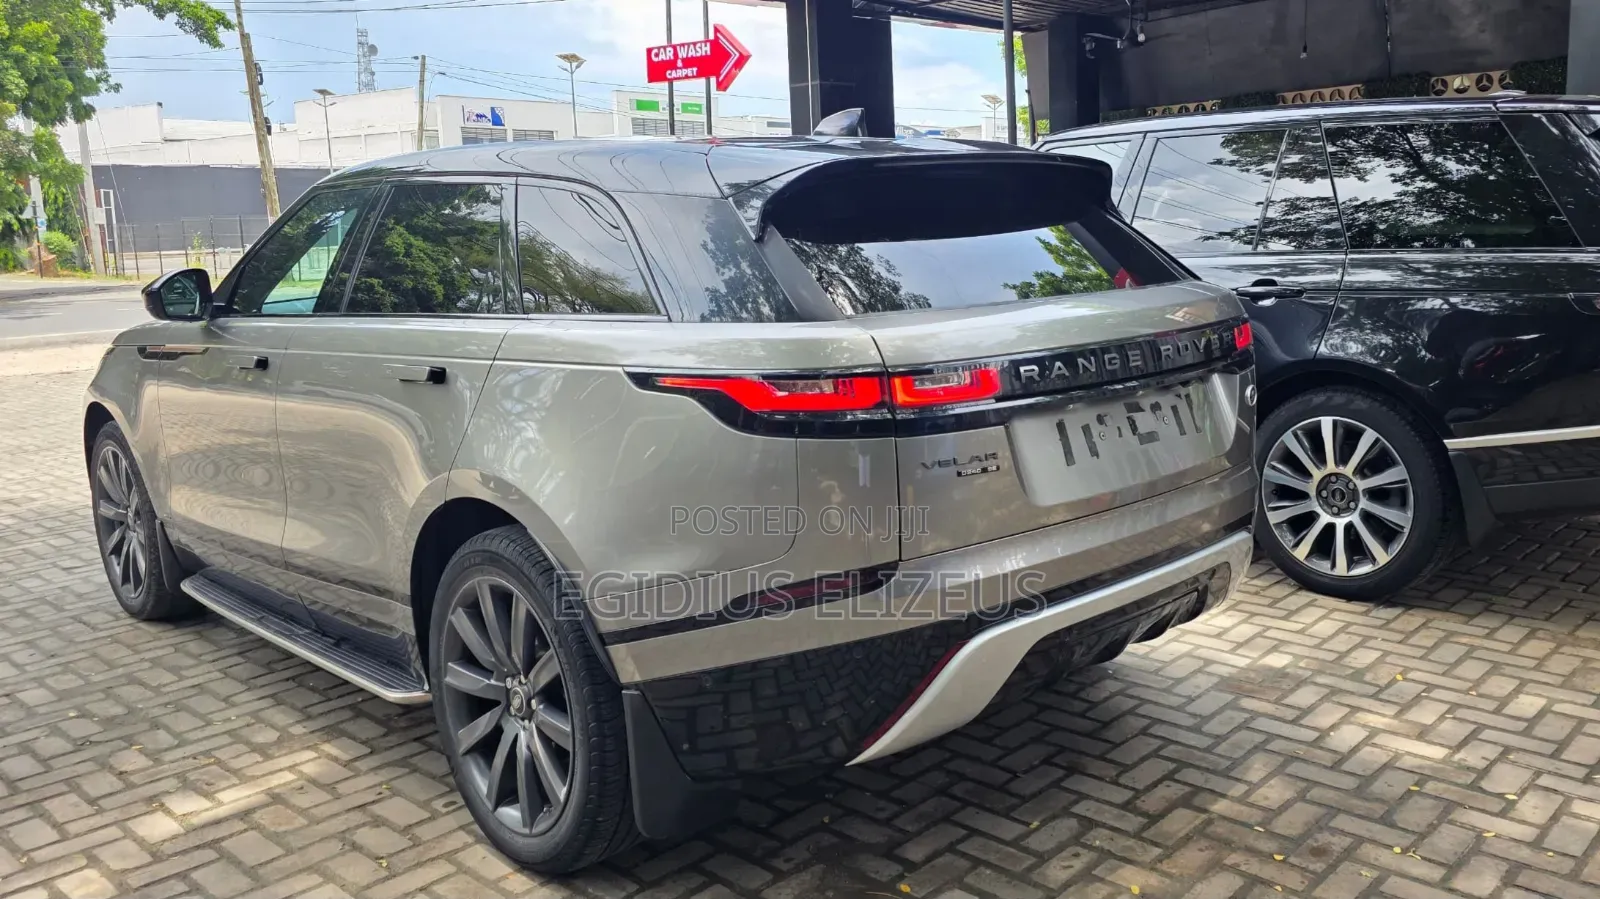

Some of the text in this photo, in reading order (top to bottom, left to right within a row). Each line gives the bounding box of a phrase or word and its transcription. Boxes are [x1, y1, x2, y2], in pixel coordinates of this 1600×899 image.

[651, 42, 711, 61] CAR WASH
[677, 59, 683, 67] &
[666, 67, 697, 78] CARPET
[1019, 349, 1142, 384] RANGE
[920, 452, 998, 470] VELAR
